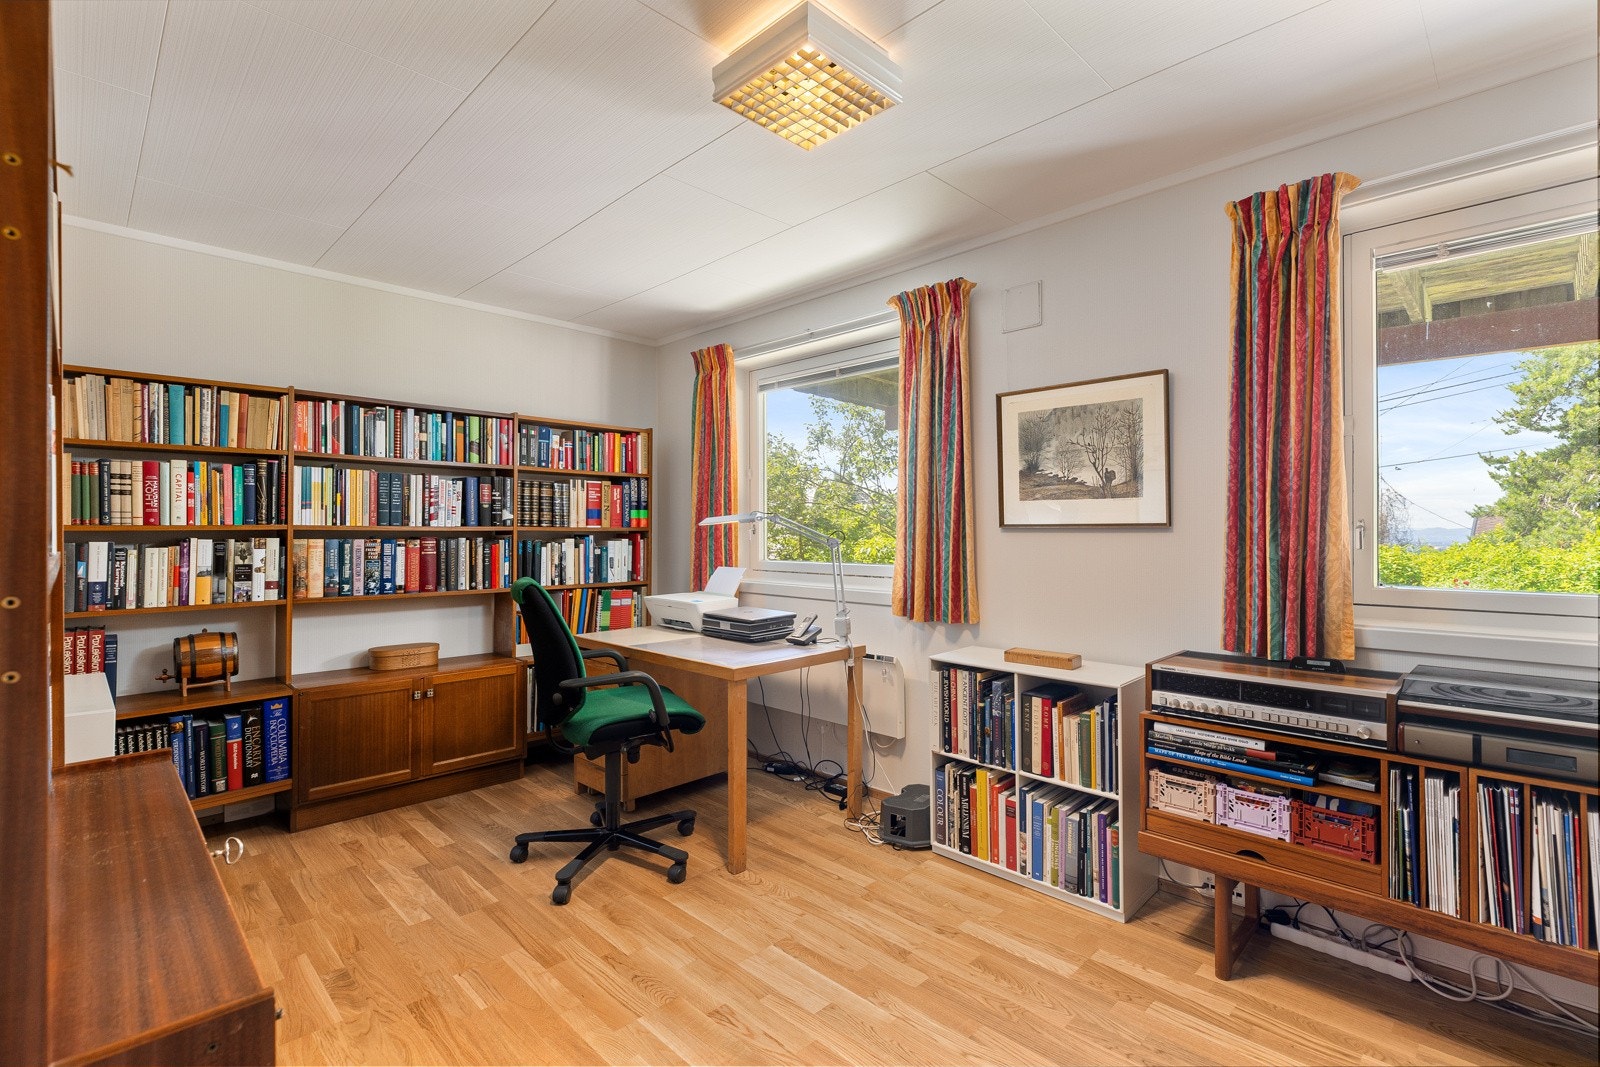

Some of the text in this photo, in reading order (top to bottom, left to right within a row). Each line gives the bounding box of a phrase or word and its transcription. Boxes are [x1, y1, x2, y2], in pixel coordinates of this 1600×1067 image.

[64, 636, 73, 673] PaxLeksikon
[76, 635, 86, 672] PaxLeksikon
[92, 634, 101, 672] PaxLeksikon
[252, 726, 261, 768] ENCARTA
[269, 720, 278, 765] ENCYCLOPEDIA
[278, 718, 287, 763] COLUMBIA
[1188, 754, 1210, 764] HEAVENS
